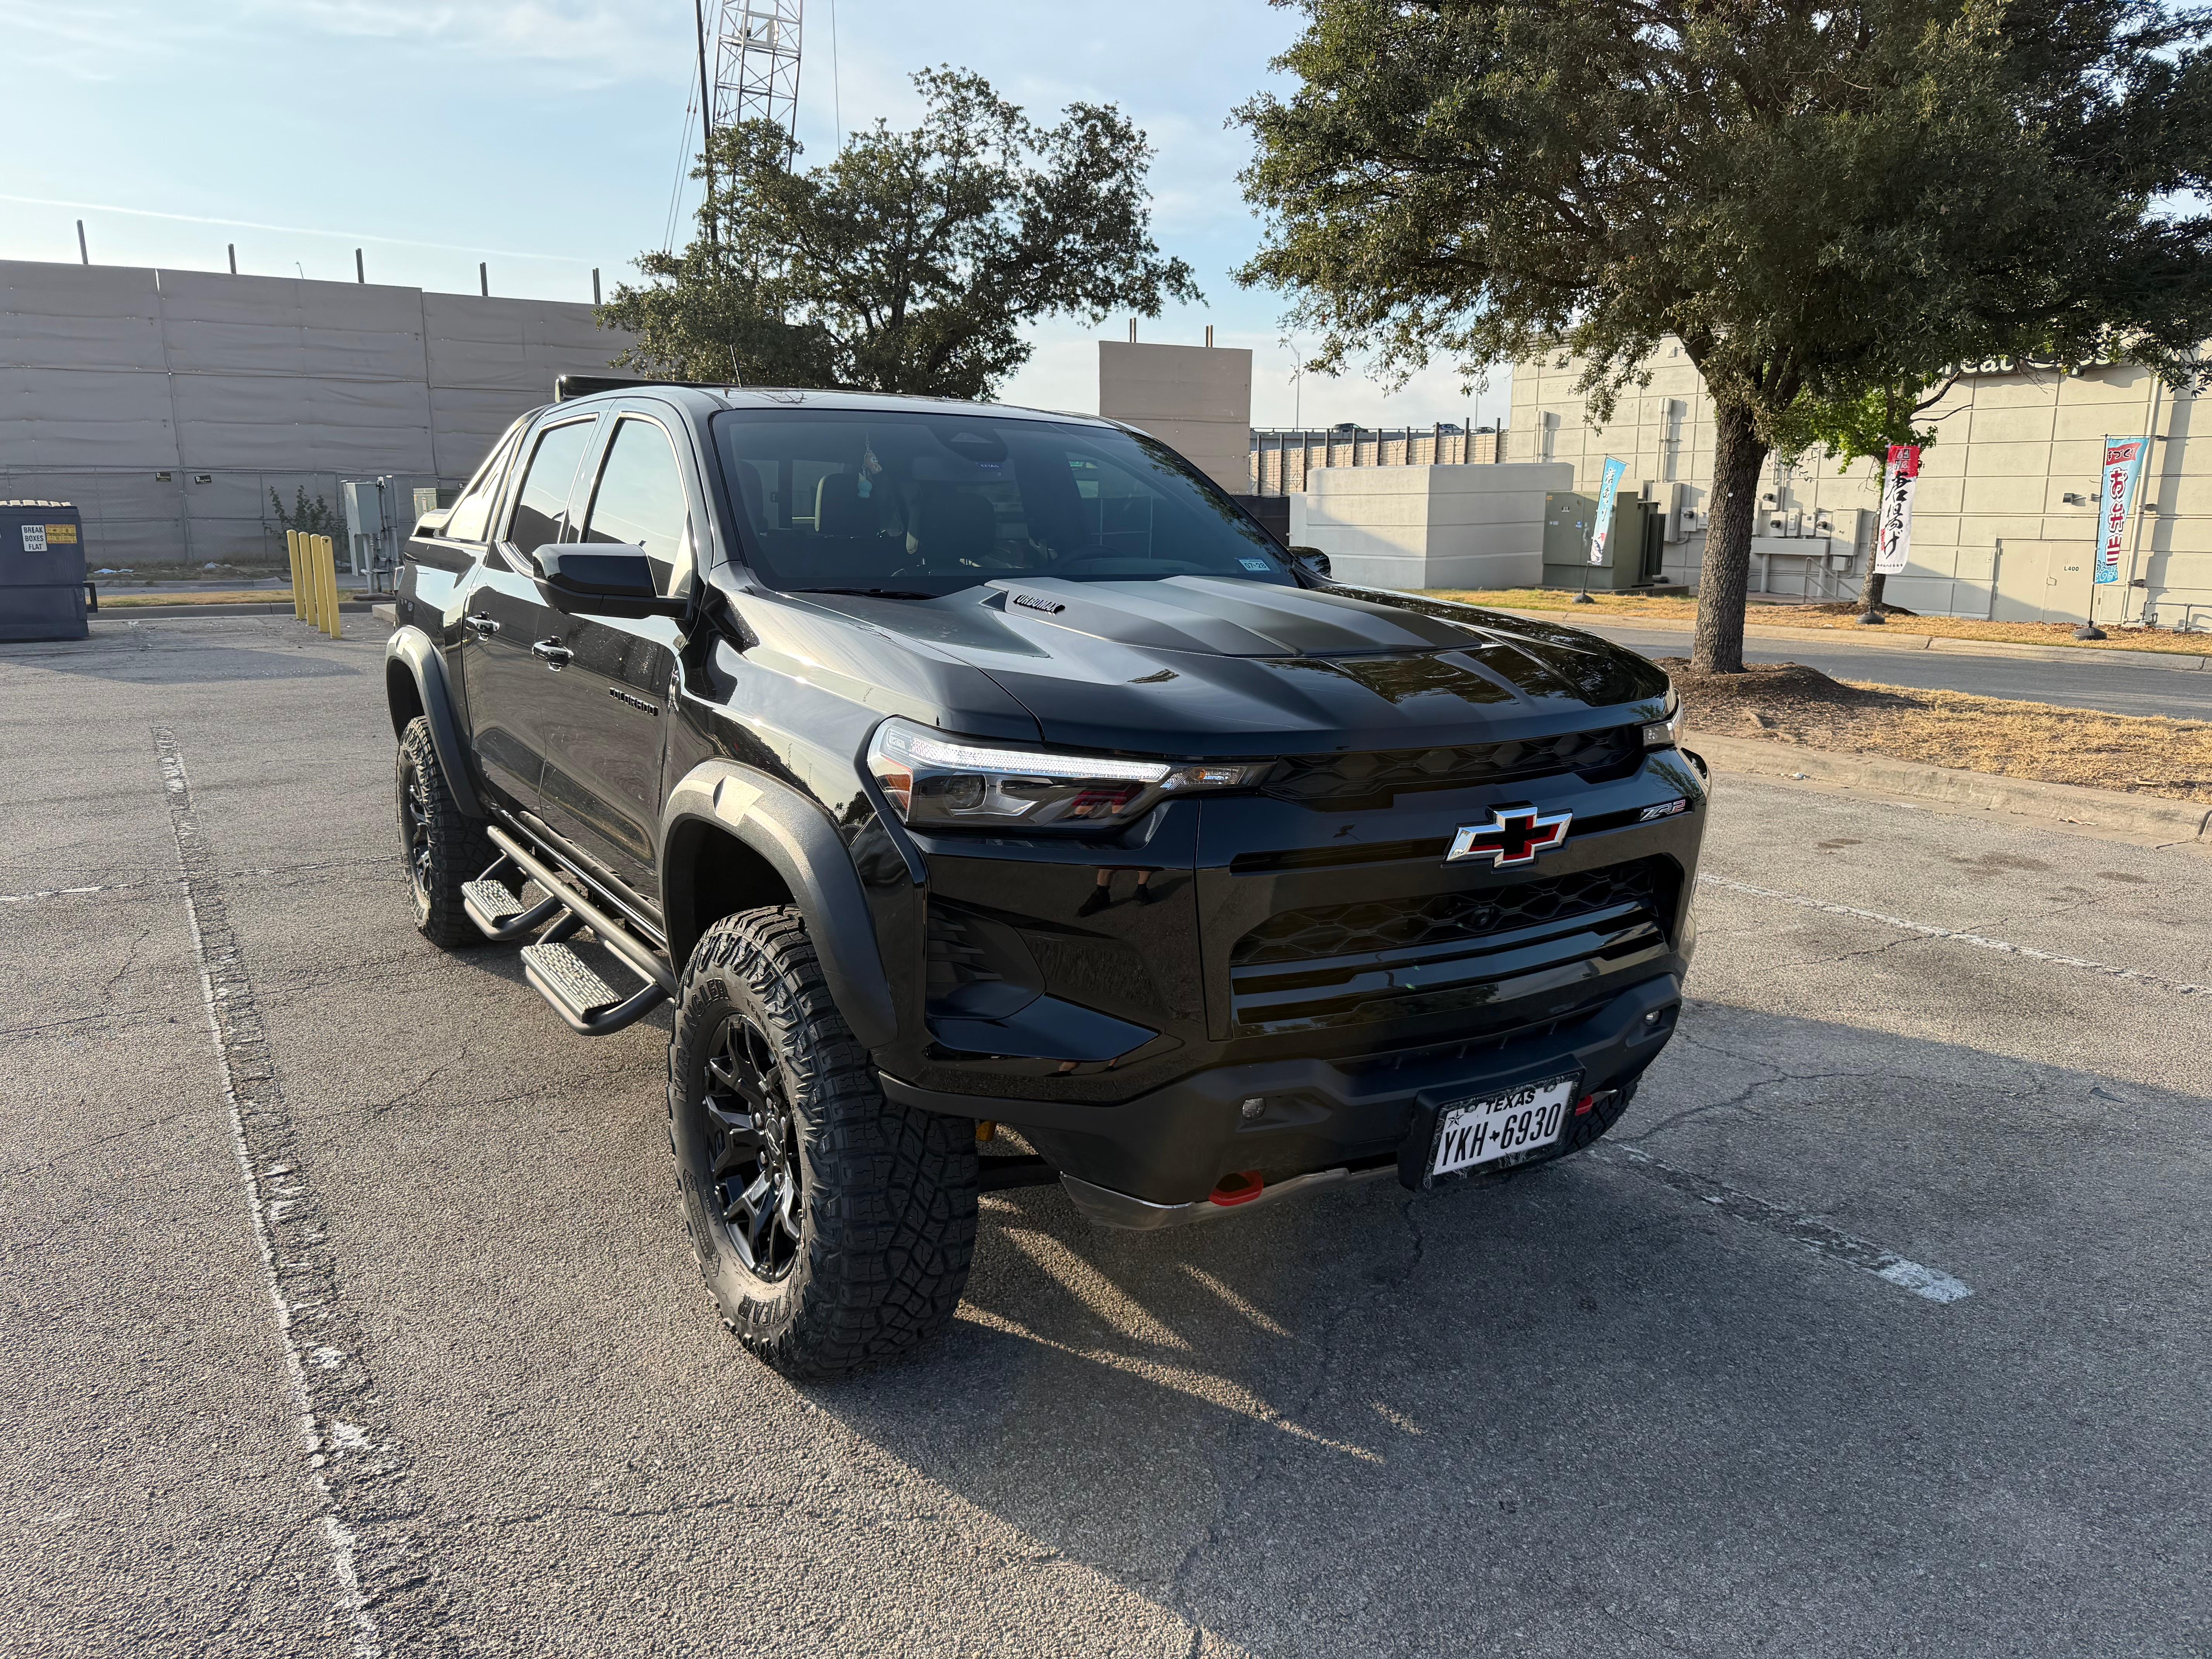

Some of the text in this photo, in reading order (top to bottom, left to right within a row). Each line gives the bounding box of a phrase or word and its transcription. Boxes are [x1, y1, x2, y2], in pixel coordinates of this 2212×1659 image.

[1013, 594, 1065, 613] TURBOMAX
[1640, 799, 1686, 821] ZR2
[674, 977, 729, 1103] WRANGLER
[1485, 1089, 1536, 1115] TEXAS
[1442, 1103, 1561, 1166] YKH 6930
